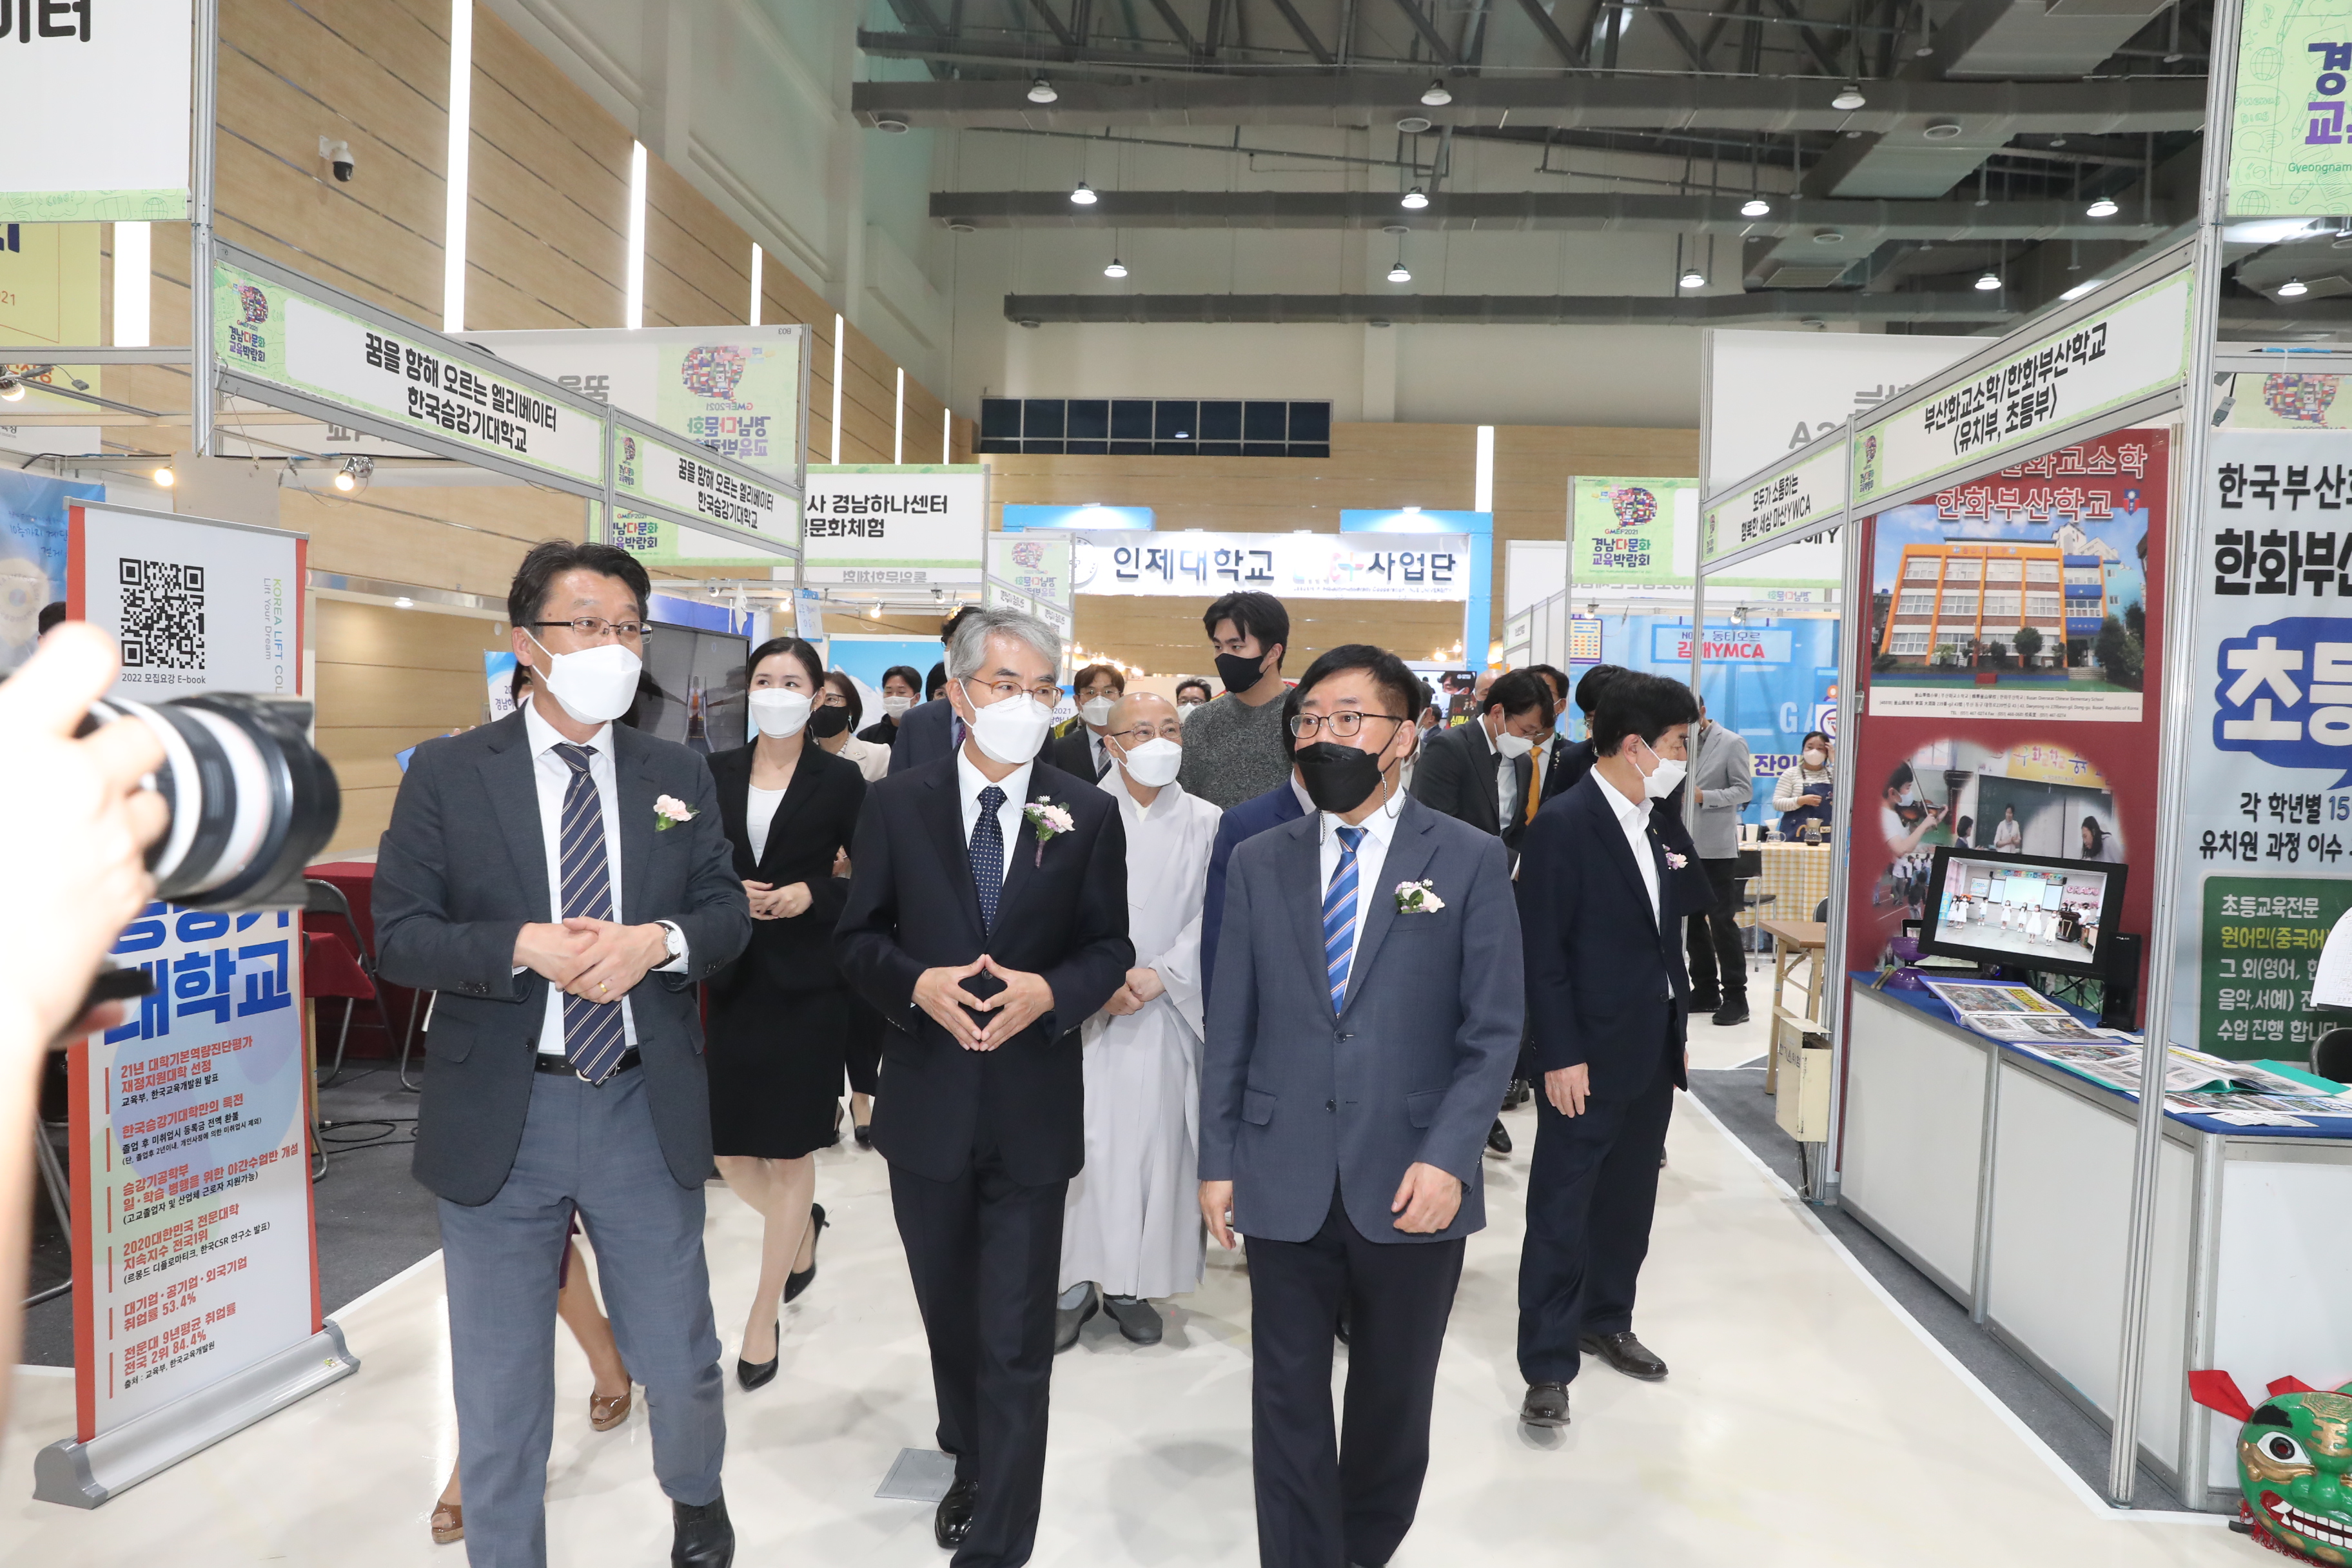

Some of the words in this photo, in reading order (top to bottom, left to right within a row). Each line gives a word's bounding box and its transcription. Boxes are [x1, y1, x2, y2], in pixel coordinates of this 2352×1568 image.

[229, 325, 266, 348] 경남다문화
[229, 340, 266, 362] 교육박람회
[365, 331, 401, 375] 꿈을
[406, 348, 439, 388] 향해
[444, 364, 487, 407] 오르는
[491, 383, 557, 432] 엘리베이터
[1924, 322, 2108, 435] 부산화교소학/한화부산학교
[407, 386, 527, 453] 한국승강기대학교
[678, 457, 695, 484] 꿈을
[698, 464, 714, 490] 향해
[715, 473, 738, 499] 오르는
[739, 482, 774, 512] 엘리베이터
[1752, 484, 1771, 512] 모두가
[1772, 473, 1798, 504] 소통하는
[2219, 462, 2352, 511] 한국부산
[698, 490, 758, 529] 한국승강기대학교
[832, 494, 948, 514] 경남하나센터
[1741, 515, 1758, 542] 행복한
[1759, 513, 1771, 533] 세상
[1772, 494, 1811, 528] 마산YWCA
[1935, 485, 2114, 524] 한화부산학교
[613, 522, 658, 536] 남다문화
[613, 536, 657, 550] 육박람회
[1592, 538, 1651, 553] 경남다문화
[1113, 547, 1275, 582] 인제대학교
[1368, 552, 1456, 582] 사업단
[1592, 553, 1651, 567] 교육박람회
[273, 578, 282, 626] KOREA
[274, 631, 283, 660] LIFT
[1678, 642, 1765, 658] 김YMCA
[1712, 631, 1761, 642] 동티모르
[122, 673, 142, 682] 2022
[144, 674, 175, 684] 모집요강
[177, 675, 206, 684] E-book
[2240, 792, 2262, 823] 각
[2268, 792, 2322, 824] 학년별
[2199, 830, 2258, 861] 유치원
[2266, 832, 2300, 863] 과정
[2308, 832, 2343, 863] 이수
[2220, 894, 2320, 919] 초등교육전문
[2219, 958, 2237, 978] 그
[2241, 957, 2300, 981] 외(영어,
[2219, 988, 2294, 1012] 음악,서예)
[2217, 1019, 2249, 1041] 수업
[2252, 1019, 2284, 1041] 진행
[121, 1061, 144, 1079] 21년
[148, 1035, 253, 1072] 대학기본역량진단평가
[121, 1065, 188, 1093] 재정지원대학
[191, 1059, 211, 1075] 선정
[121, 1093, 148, 1107] 교육부,
[152, 1077, 202, 1098] 한국교육개발원
[204, 1073, 219, 1084] 발표
[122, 1099, 219, 1139] 한국승강기대학만의
[222, 1093, 244, 1108] 특전
[122, 1140, 139, 1155] 졸업
[142, 1138, 149, 1149] 후
[152, 1129, 181, 1144] 미취업시
[184, 1121, 206, 1135] 등록금
[208, 1116, 222, 1128] 전액
[224, 1111, 239, 1124] 환불
[181, 1132, 209, 1148] 개인사정에
[210, 1128, 222, 1138] 의한
[224, 1122, 246, 1134] 미취업시
[248, 1117, 262, 1128] 제외)
[122, 1163, 189, 1197] 승강기공학부
[168, 1174, 200, 1195] 병행을
[203, 1166, 224, 1181] 위한
[228, 1150, 279, 1177] 야간수업반
[281, 1142, 299, 1157] 개설
[123, 1202, 166, 1226] (고교졸업자
[168, 1198, 176, 1210] 및
[179, 1190, 201, 1206] 산업체
[202, 1183, 224, 1197] 근로자
[226, 1170, 259, 1188] 지원가능)
[123, 1219, 194, 1257] 2020대한민국
[197, 1202, 240, 1226] 전문대학
[124, 1246, 169, 1271] 지속지수
[173, 1228, 209, 1253] 전국1위
[124, 1267, 151, 1285] (르몽드
[153, 1248, 199, 1273] 디플로마티크,
[201, 1237, 229, 1255] 한국CSR
[230, 1228, 251, 1243] 연구소
[253, 1221, 271, 1234] 발표)
[124, 1306, 159, 1332] 취업률
[162, 1291, 197, 1316] 53.4%
[124, 1335, 159, 1362] 전문대
[162, 1317, 201, 1344] 9년평균
[204, 1302, 237, 1325] 취업률
[124, 1356, 148, 1377] 전국
[152, 1346, 170, 1364] 2위
[172, 1329, 206, 1354] 84.4%
[145, 1364, 168, 1380] 교육부,
[169, 1341, 215, 1369] 한국교육개발원
